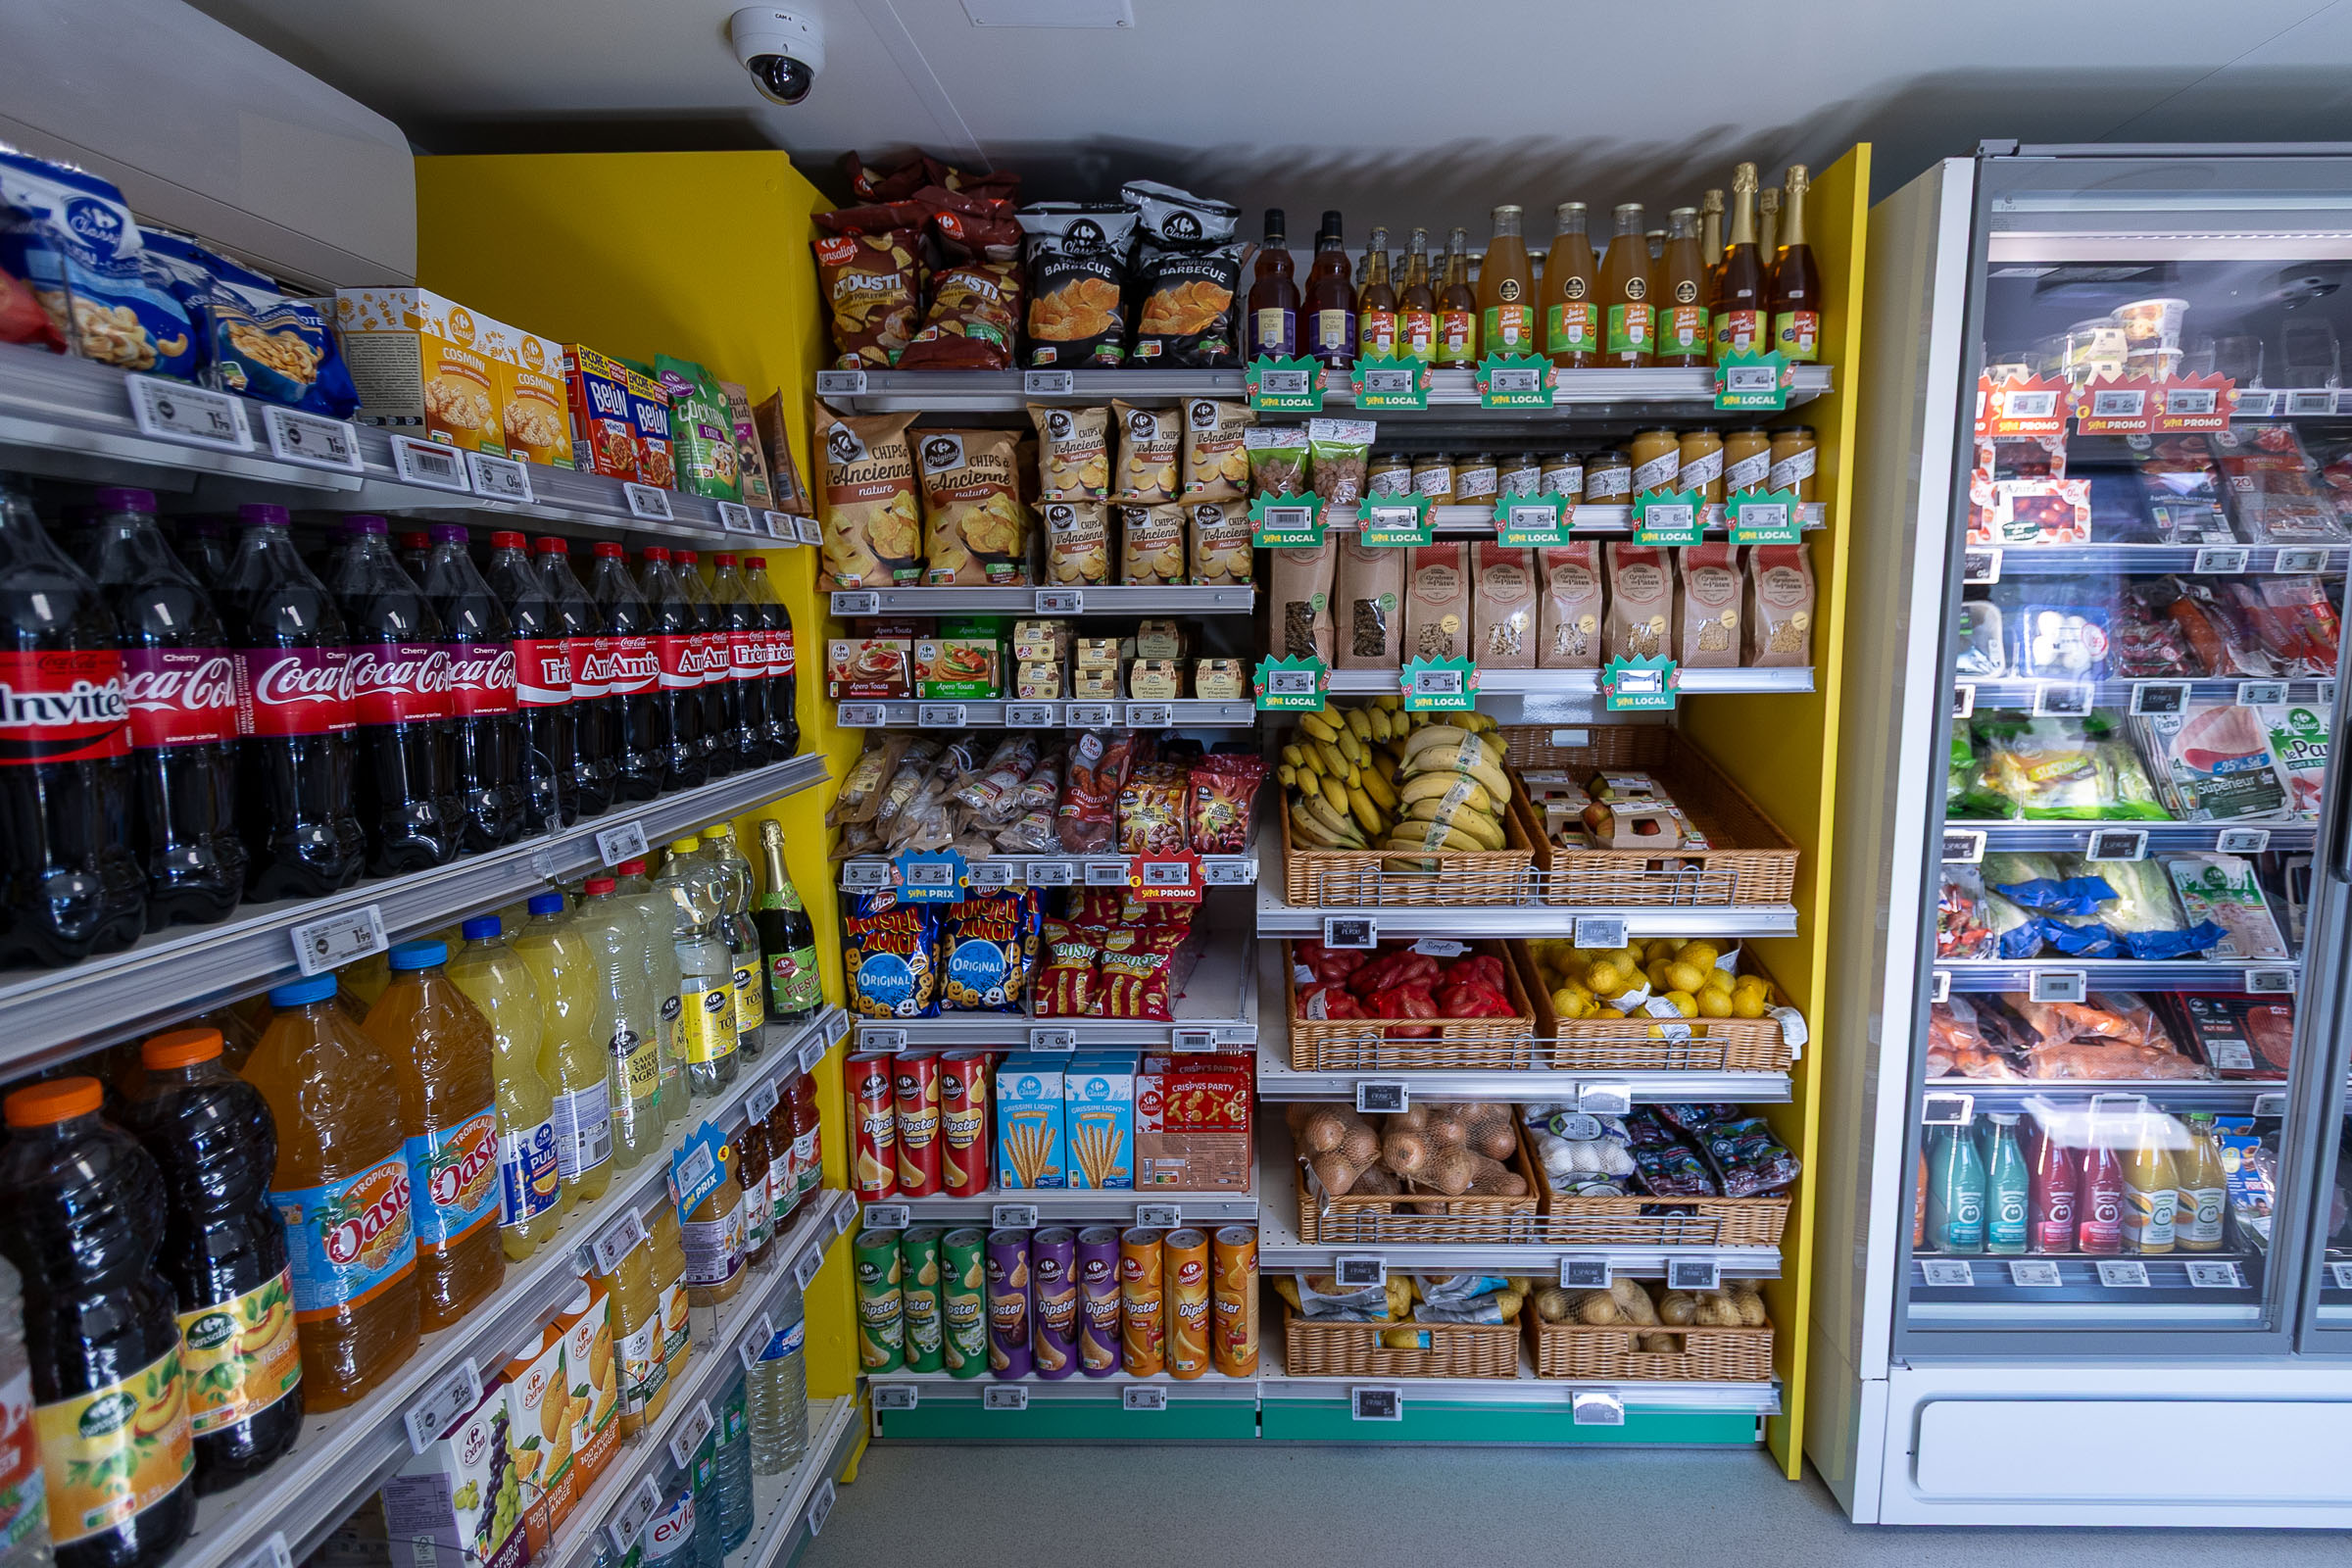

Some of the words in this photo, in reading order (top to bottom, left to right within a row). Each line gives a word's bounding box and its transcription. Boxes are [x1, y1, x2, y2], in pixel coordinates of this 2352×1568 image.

[1045, 262, 1112, 278] BARBECUE
[1159, 266, 1227, 283] BARBECUE
[443, 347, 485, 372] COSMINI
[517, 373, 554, 395] COSMINI
[1280, 398, 1314, 407] LOCAL
[1511, 395, 1544, 404] LOCAL
[1741, 396, 1777, 405] LOCAL
[677, 399, 730, 431] COCKTAIL
[2183, 417, 2223, 427] PROMO
[2019, 420, 2059, 430] PROMO
[2107, 420, 2147, 429] PROMO
[871, 445, 903, 460] CHIPS
[927, 449, 960, 466] Original
[969, 454, 1000, 467] CHIPS
[826, 463, 911, 486] l'Ancienne
[858, 483, 895, 497] nature
[955, 487, 990, 498] nature
[1283, 534, 1315, 543] LOCAL
[1527, 533, 1560, 542] LOCAL
[1660, 532, 1693, 542] LOCAL
[163, 654, 200, 663] Cherry
[401, 647, 427, 656] Cherry
[610, 651, 660, 678] Amis
[0, 680, 128, 723] Invité
[1285, 697, 1316, 707] LOCAL
[1434, 698, 1466, 707] LOCAL
[2198, 776, 2256, 796] Supérieur
[1070, 786, 1108, 804] CHORIZO
[929, 889, 955, 898] PRIX
[947, 897, 1019, 923] MONSTER
[846, 906, 924, 936] MONSTER
[956, 921, 1016, 941] MUNCH
[861, 933, 920, 955] MUNCH
[953, 957, 1001, 973] ORIGINAL
[860, 972, 911, 988] ORIGINAL
[1213, 1064, 1239, 1073] PARTY
[1171, 1081, 1206, 1092] CRISPY'S
[1207, 1082, 1234, 1092] PARTY
[1004, 1104, 1032, 1113] GRISSINI
[453, 1117, 489, 1147] TROPICAL
[898, 1116, 938, 1132] Dipster
[942, 1117, 980, 1132] Dipster
[430, 1128, 499, 1206] Oasis
[352, 1164, 396, 1198] TROPICAL
[696, 1176, 717, 1198] PRIX
[327, 1175, 411, 1265] Oasis
[860, 1298, 900, 1316] Dipster
[1039, 1299, 1076, 1316] Dipster
[1123, 1299, 1160, 1313] Dipster
[575, 1334, 595, 1357] Extra
[525, 1382, 547, 1408] Extra
[464, 1436, 487, 1463] Extra
[587, 1432, 617, 1468] ORANGE
[562, 1472, 575, 1493] JUS
[654, 1500, 695, 1543] evia
